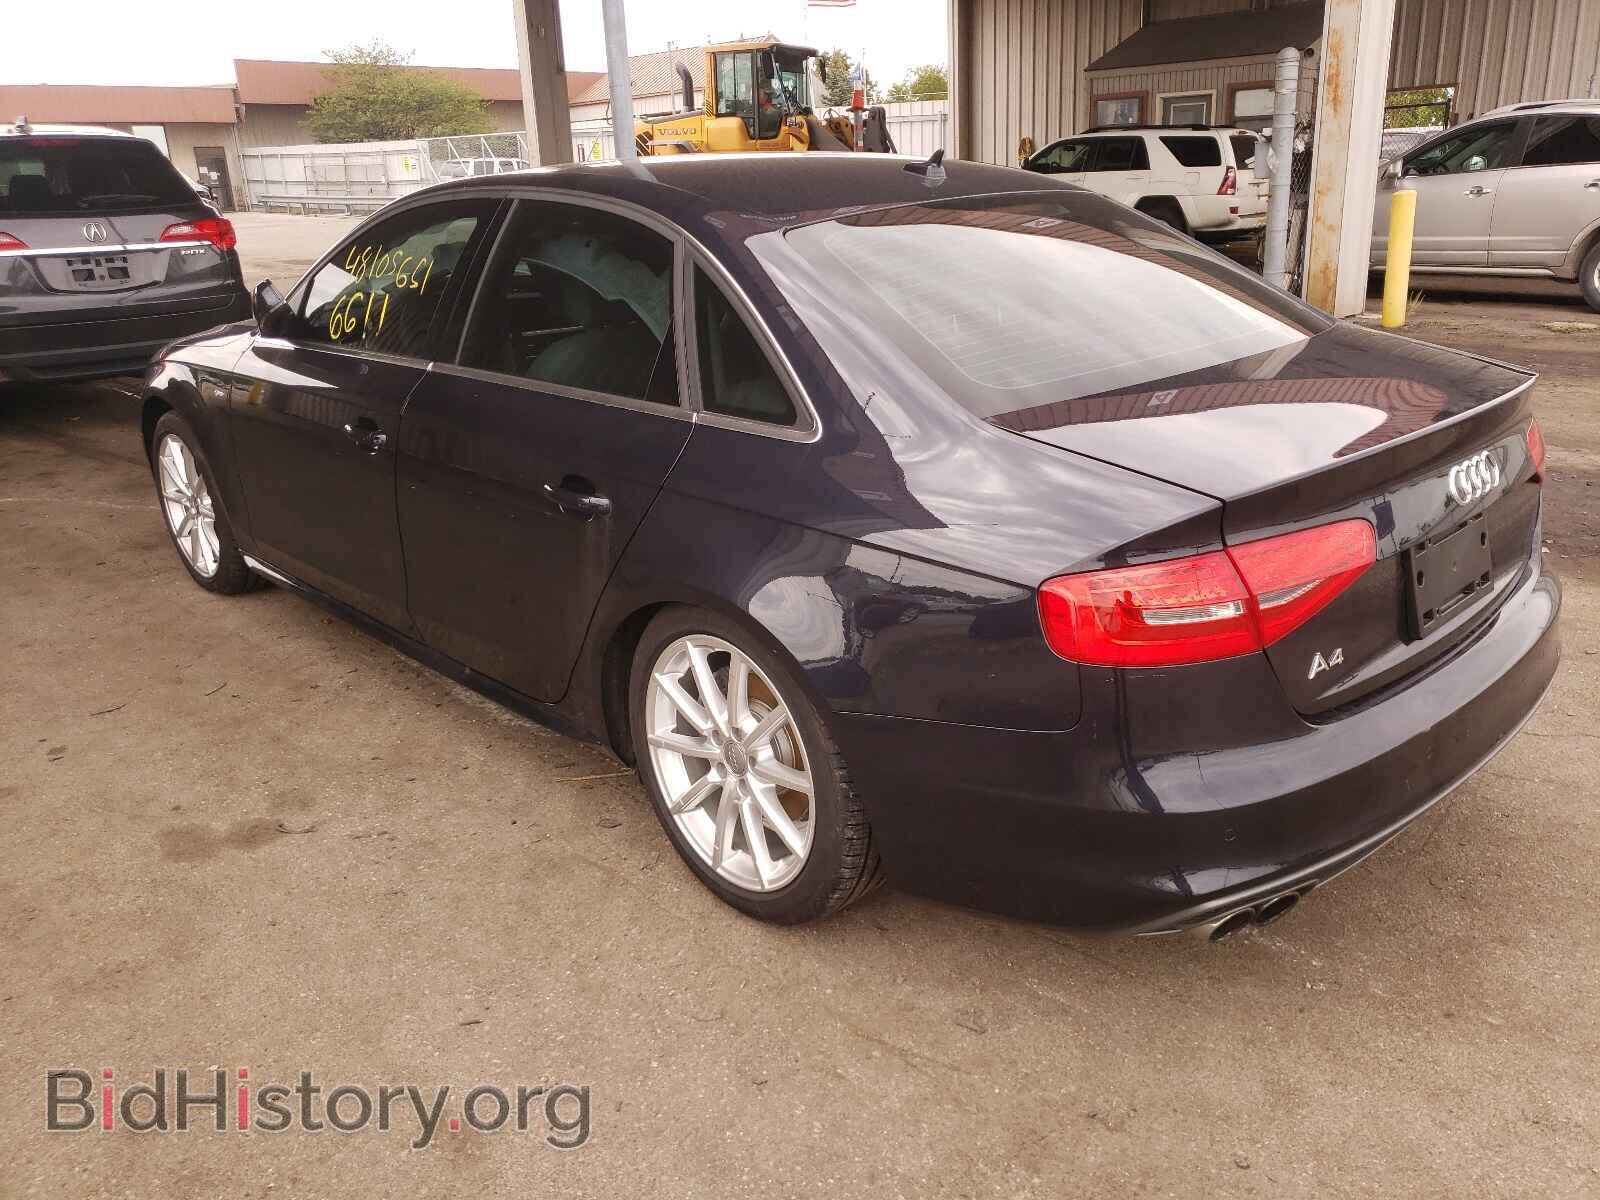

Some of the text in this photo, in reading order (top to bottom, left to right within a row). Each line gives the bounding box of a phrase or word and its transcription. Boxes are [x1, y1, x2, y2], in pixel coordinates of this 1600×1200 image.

[656, 127, 697, 136] VOLVO
[329, 289, 389, 340] 6611
[1308, 648, 1344, 680] A4
